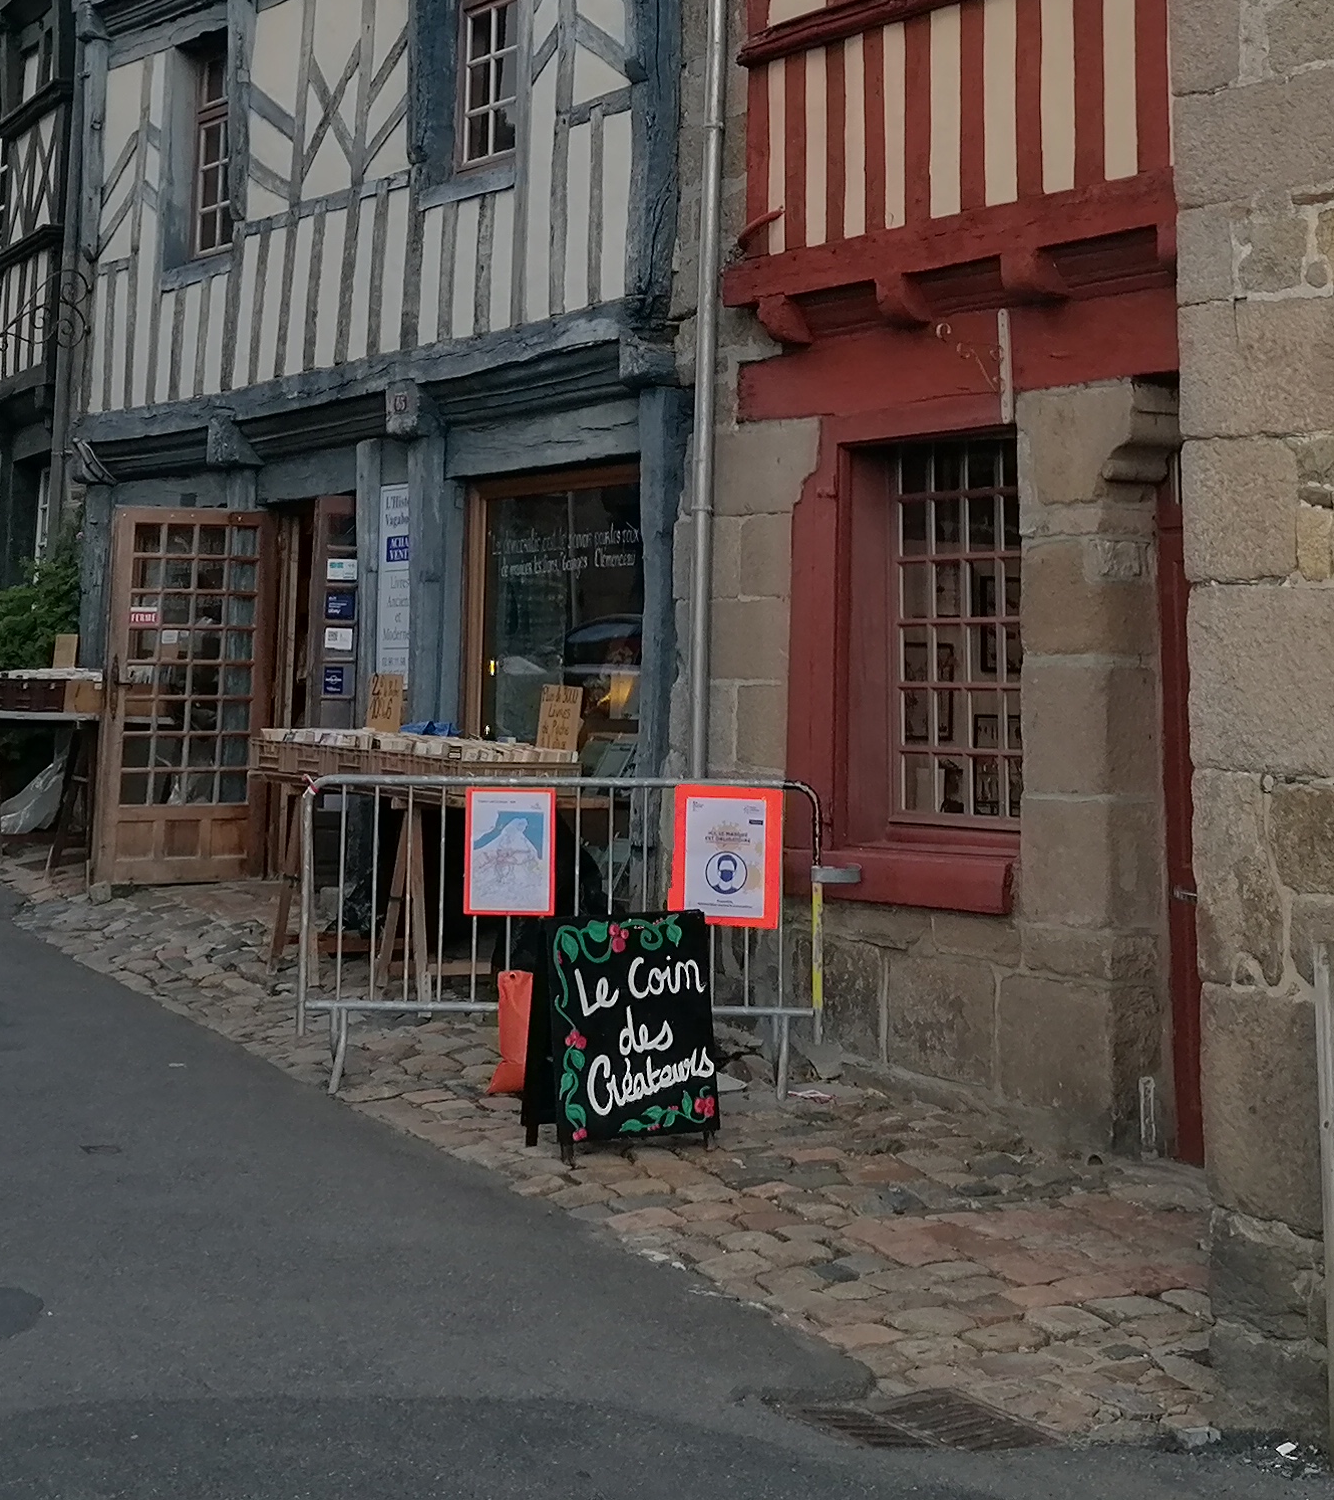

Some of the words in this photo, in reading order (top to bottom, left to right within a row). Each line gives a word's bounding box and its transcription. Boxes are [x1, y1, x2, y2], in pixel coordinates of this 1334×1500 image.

[574, 969, 619, 1018] Le
[627, 955, 707, 1000] Coin
[618, 1006, 673, 1057] des
[586, 1046, 715, 1116] Créateurs
